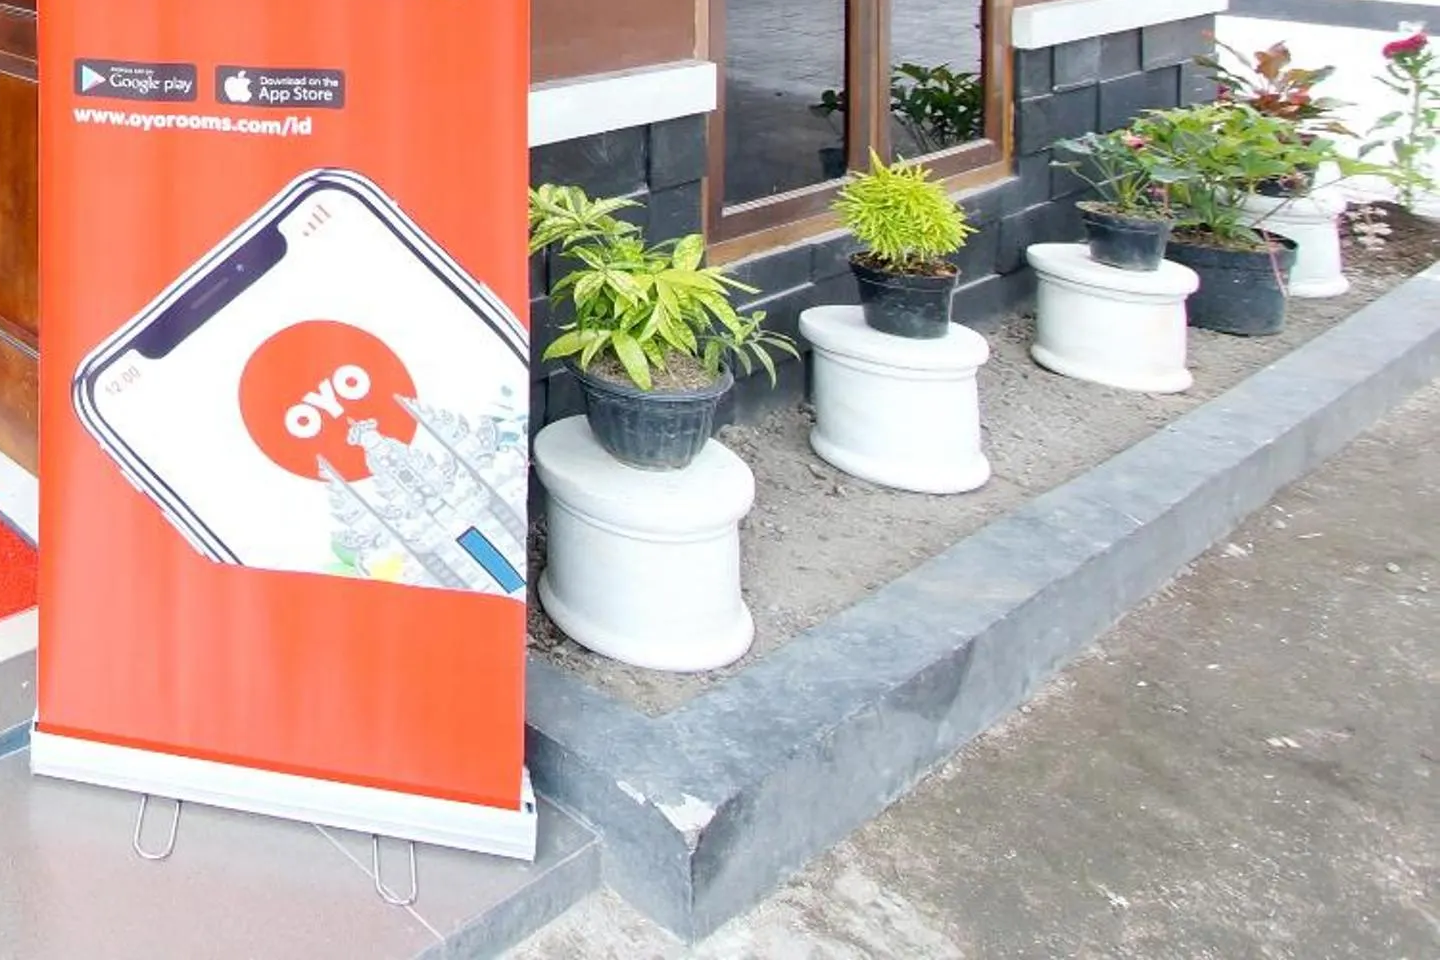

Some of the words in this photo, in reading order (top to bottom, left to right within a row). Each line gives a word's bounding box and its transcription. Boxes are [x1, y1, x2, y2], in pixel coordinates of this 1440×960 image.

[109, 73, 160, 94] Google
[164, 76, 193, 94] play
[259, 86, 291, 103] App
[293, 86, 333, 101] Store
[73, 107, 312, 136] www.oyorooms.com/id
[104, 364, 141, 396] 1200
[284, 364, 371, 439] OYO
